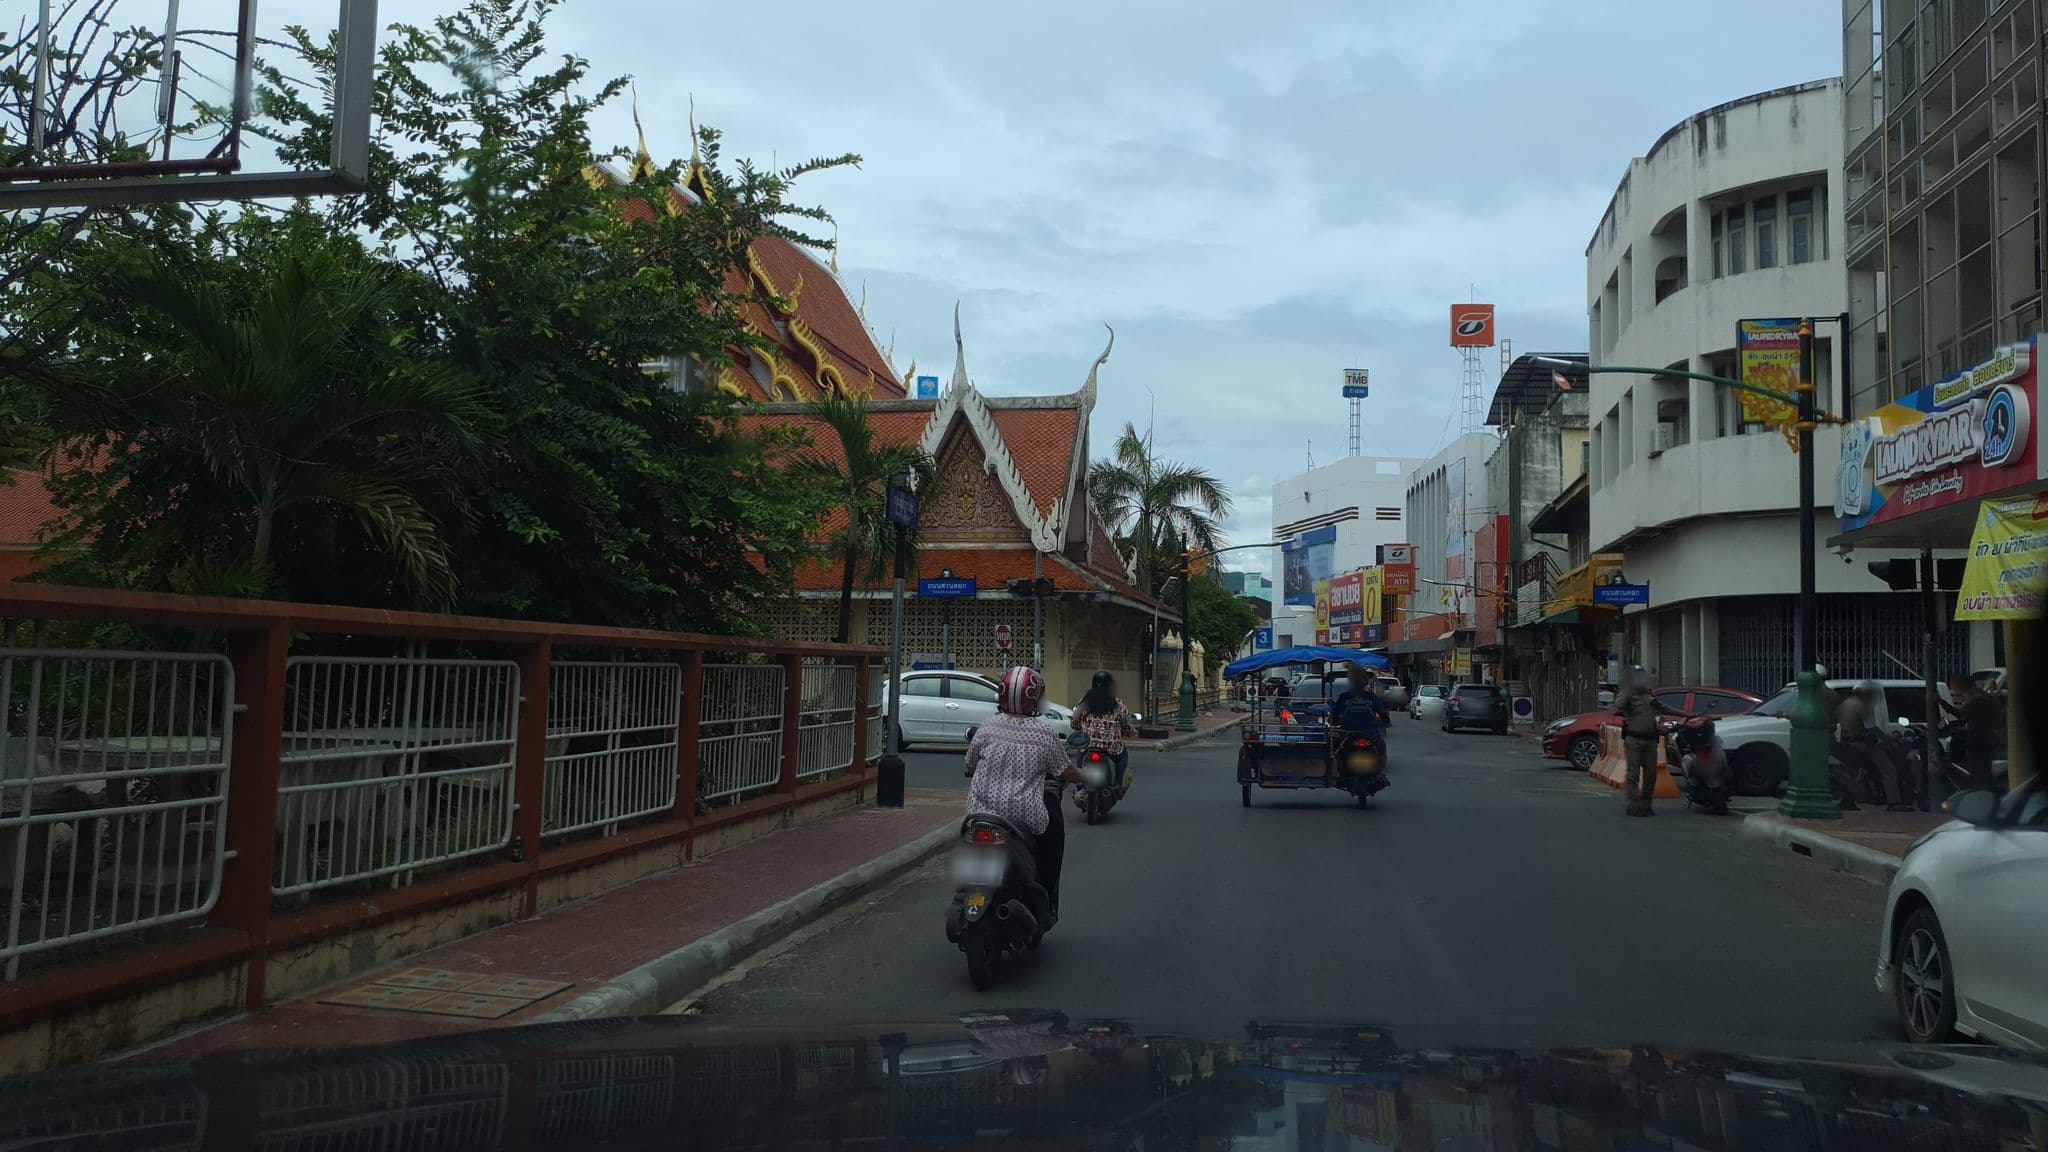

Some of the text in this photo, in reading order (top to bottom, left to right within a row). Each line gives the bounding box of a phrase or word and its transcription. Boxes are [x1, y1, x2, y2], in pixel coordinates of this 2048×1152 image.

[1747, 331, 1799, 341] LAUNDRYBA
[1346, 375, 1368, 385] TMB
[1876, 412, 1974, 477] LAUNDRYBAR
[1259, 631, 1268, 644] 3
